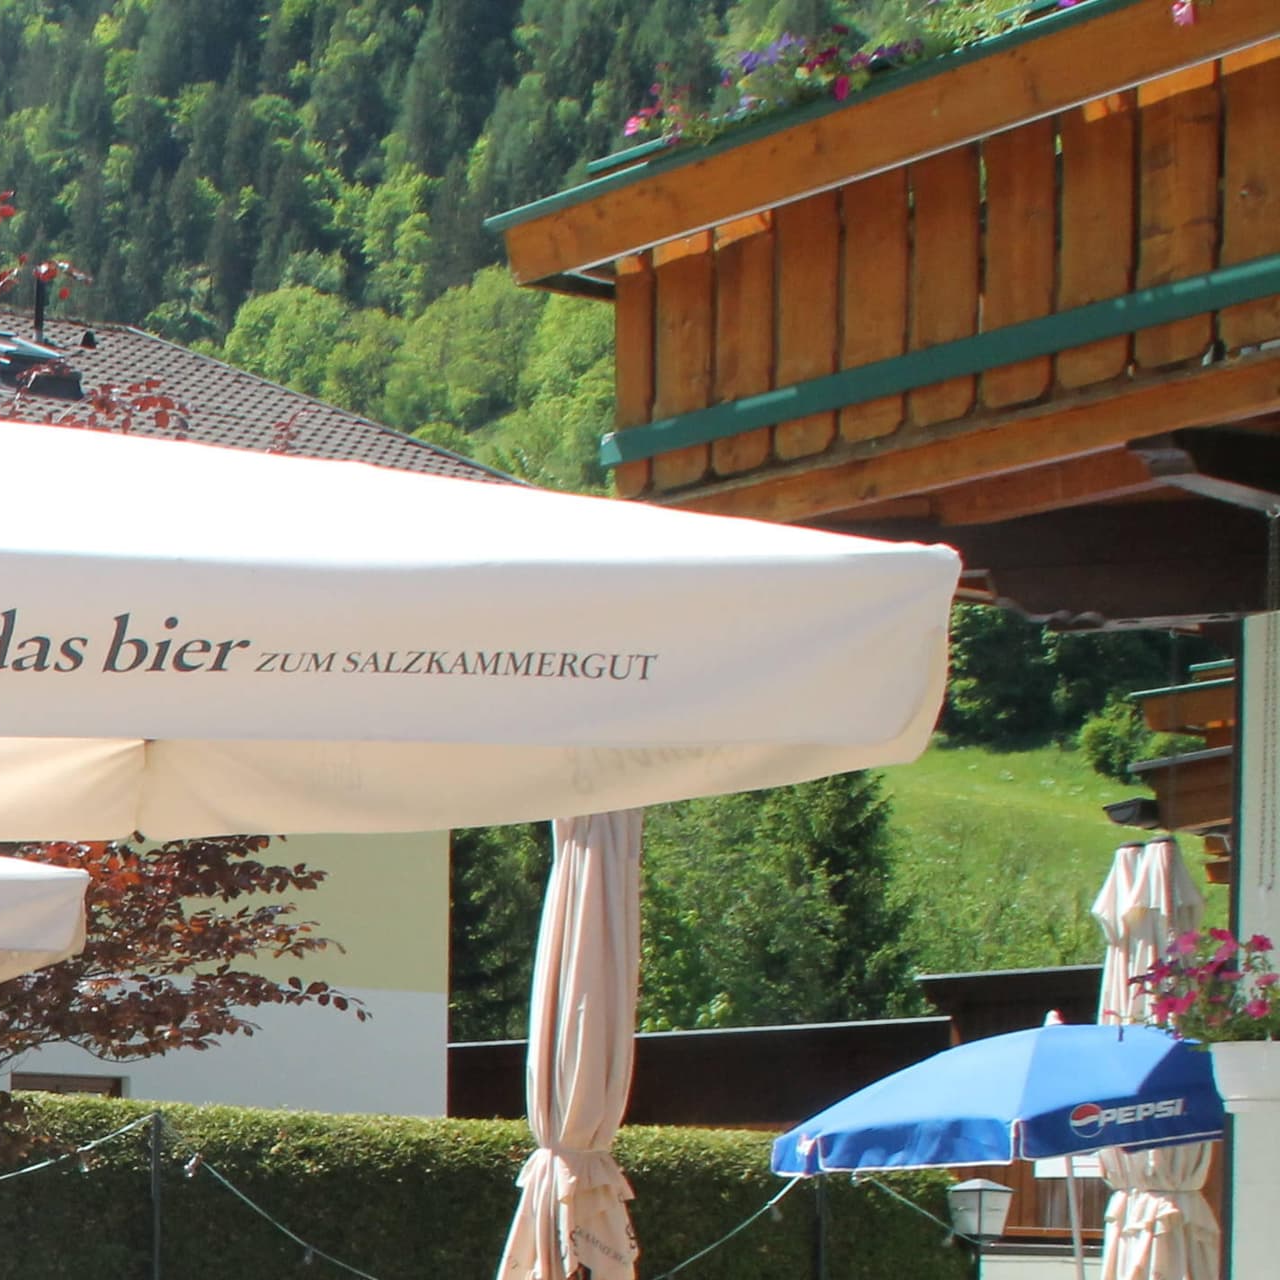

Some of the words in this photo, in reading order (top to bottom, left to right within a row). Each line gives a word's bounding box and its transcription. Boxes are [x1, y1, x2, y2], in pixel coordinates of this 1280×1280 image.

[101, 612, 251, 674] bier
[254, 651, 338, 674] ZUM
[342, 650, 658, 681] SALZKAMMERGUT
[1098, 1099, 1183, 1127] PEPSI
